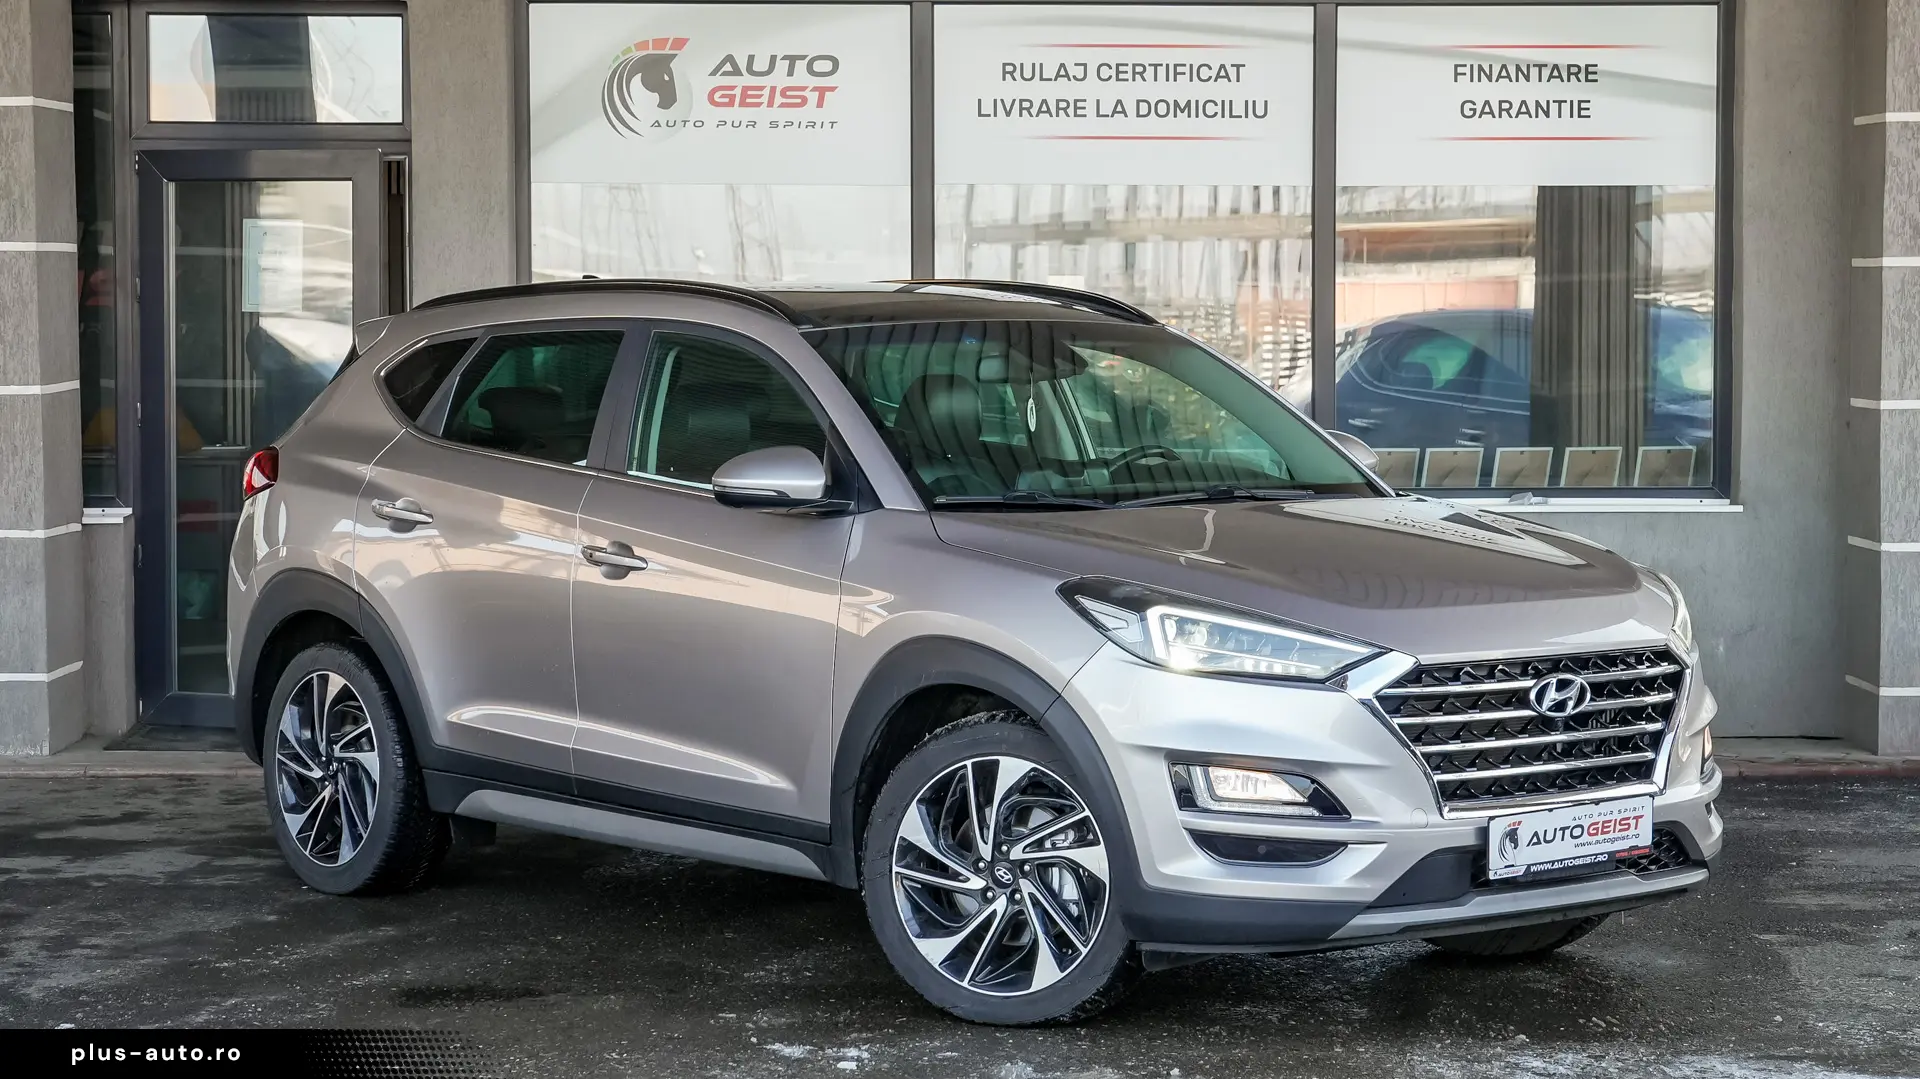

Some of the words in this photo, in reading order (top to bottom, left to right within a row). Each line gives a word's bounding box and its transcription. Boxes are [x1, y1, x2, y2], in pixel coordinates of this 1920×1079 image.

[708, 54, 840, 77] AUTO
[1001, 62, 1088, 82] RULAJ
[1096, 62, 1246, 83] CERTIFICAT
[1453, 63, 1599, 83] FINANTARE
[707, 85, 839, 109] GEIST
[977, 98, 1087, 118] LIVRARE
[1095, 99, 1128, 118] LA
[1135, 99, 1269, 119] DOMICILIU
[1460, 99, 1591, 119] GARANTIE
[650, 119, 705, 129] AUTO
[716, 119, 757, 129] PUR
[768, 120, 839, 130] SPIRIT
[1571, 813, 1594, 822] AUTO
[1597, 810, 1614, 818] PUR
[1617, 805, 1646, 816] SPIRIT
[1574, 833, 1640, 849] www.autogeist.ro
[1530, 853, 1609, 873] WWW.AUTOGEIST.RO
